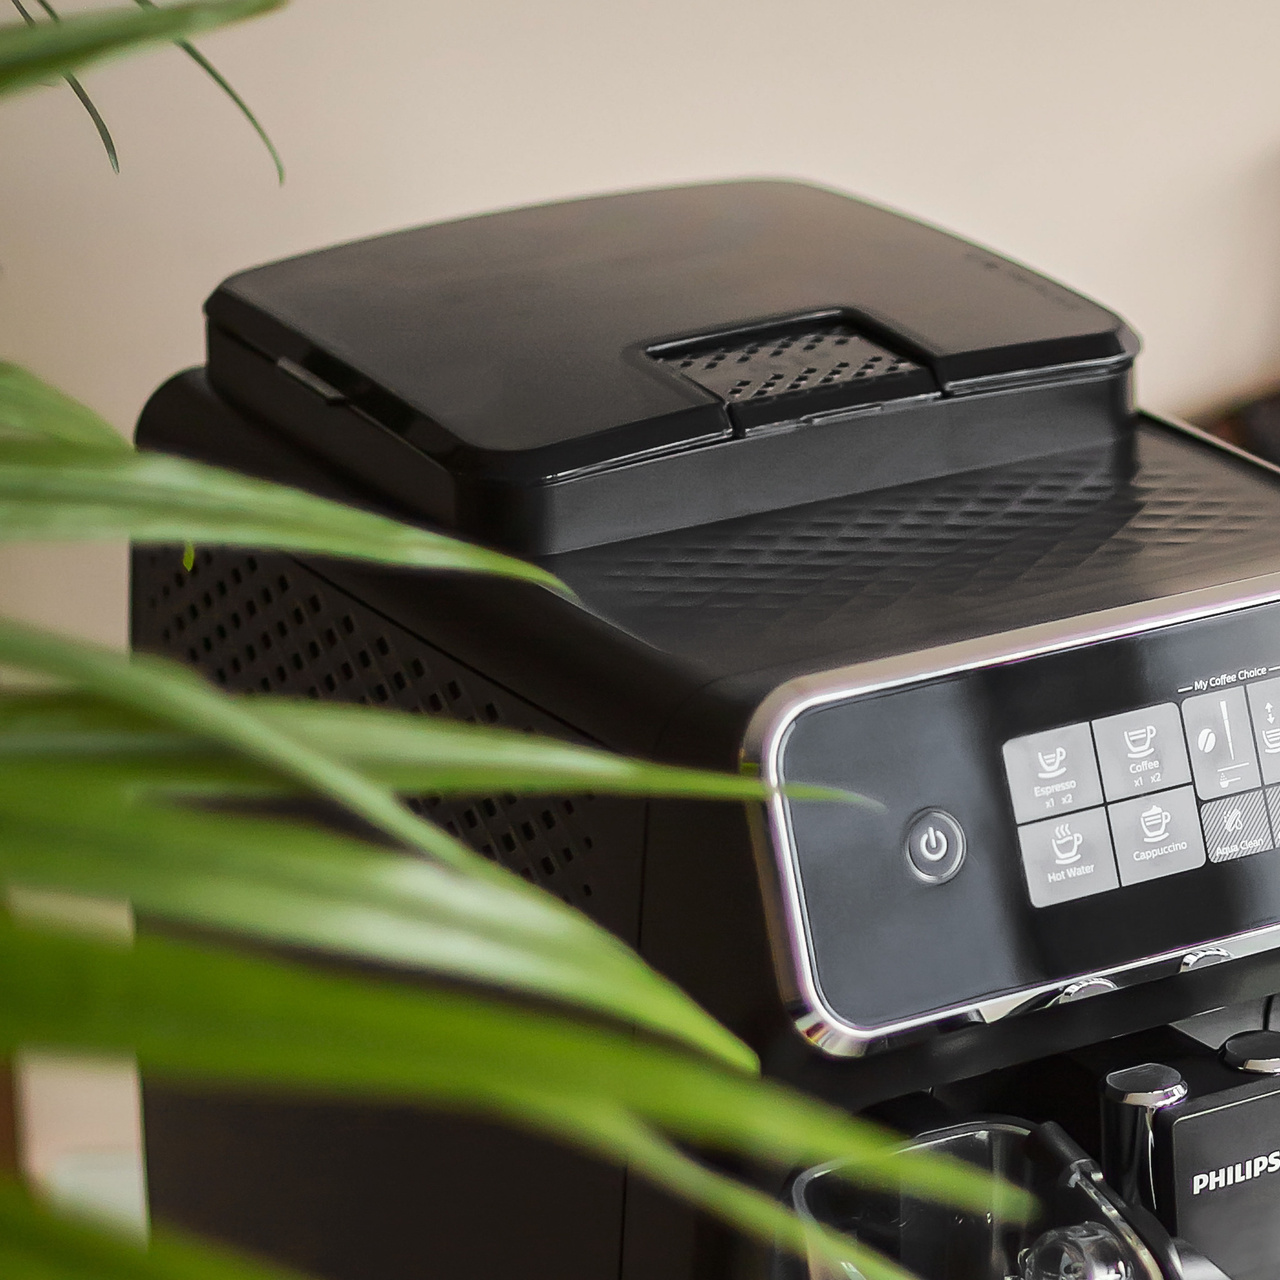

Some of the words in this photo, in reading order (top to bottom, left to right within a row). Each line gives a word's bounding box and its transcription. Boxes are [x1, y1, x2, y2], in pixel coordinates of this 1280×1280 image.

[1194, 679, 1208, 691] My
[1209, 673, 1237, 687] Coffee
[1237, 666, 1267, 681] Choice
[1129, 759, 1160, 774] Coffee
[1034, 779, 1077, 798] Espresso
[1133, 776, 1144, 788] x1
[1150, 772, 1162, 784] x2
[1045, 797, 1056, 809] x1
[1061, 793, 1073, 805] x2
[1132, 840, 1188, 862] Cappuccino
[1239, 836, 1264, 851] Clean
[1047, 870, 1067, 884] Hot
[1066, 863, 1095, 879] Water
